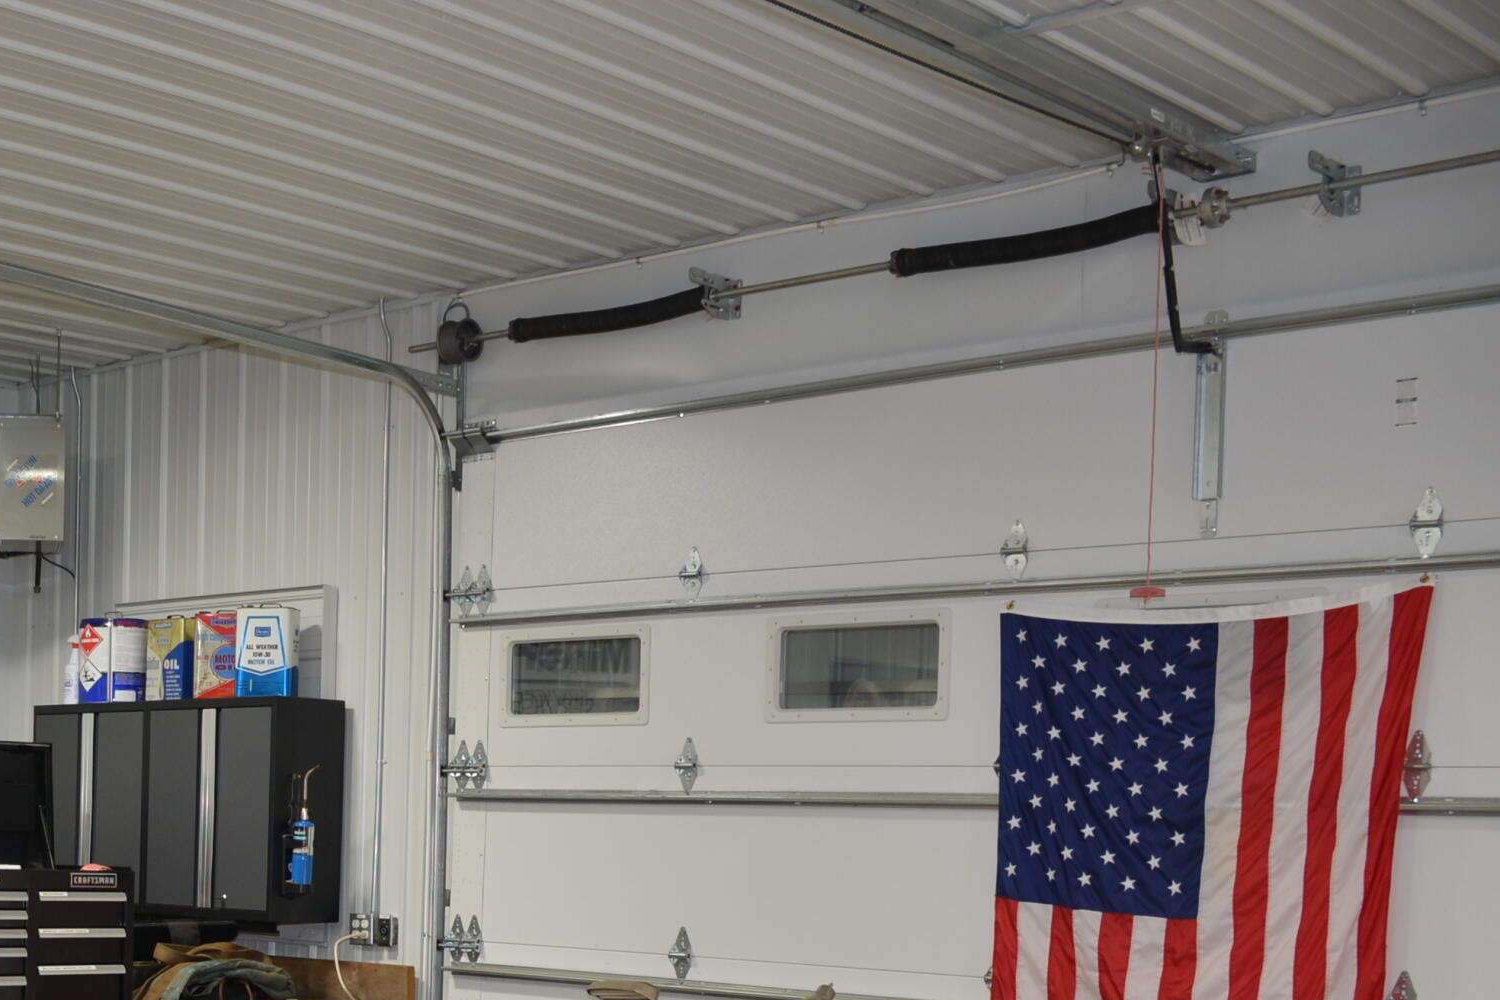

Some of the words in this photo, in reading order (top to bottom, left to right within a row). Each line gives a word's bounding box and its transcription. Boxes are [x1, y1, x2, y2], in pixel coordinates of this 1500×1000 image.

[214, 654, 236, 663] MOTO
[163, 659, 180, 670] OIL
[73, 875, 115, 885] CRAFTSMAN
